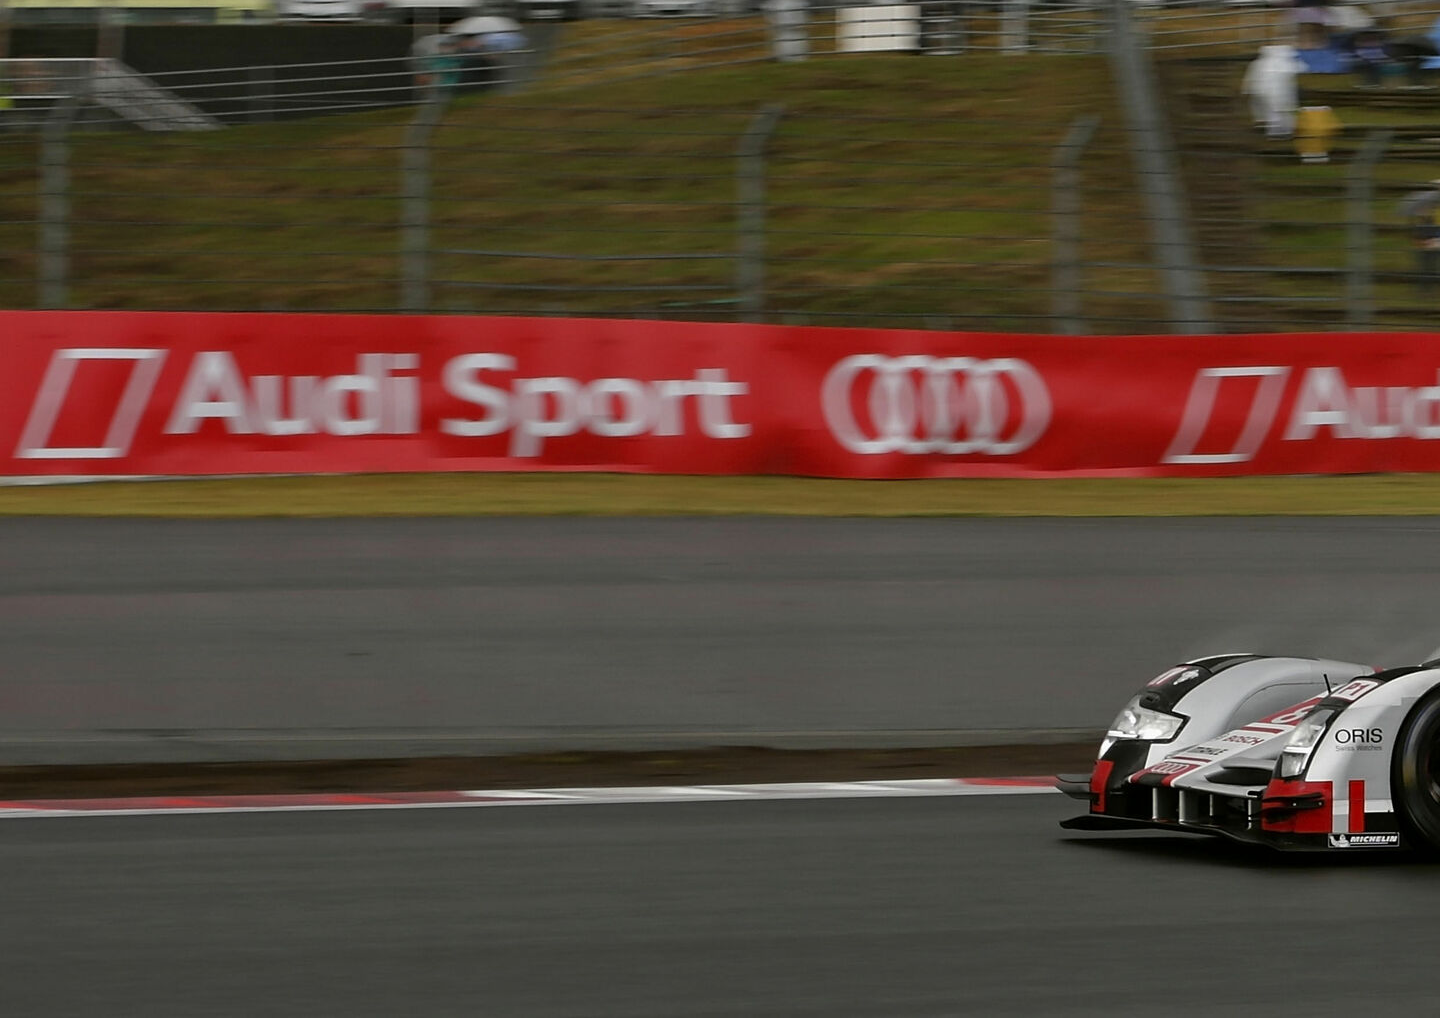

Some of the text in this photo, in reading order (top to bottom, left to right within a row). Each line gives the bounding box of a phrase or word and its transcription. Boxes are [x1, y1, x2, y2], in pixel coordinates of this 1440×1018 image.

[163, 350, 750, 458] Audi Sport
[1338, 682, 1370, 696] P1
[1335, 728, 1383, 744] ORIS
[1350, 835, 1398, 843] MICHELIN
